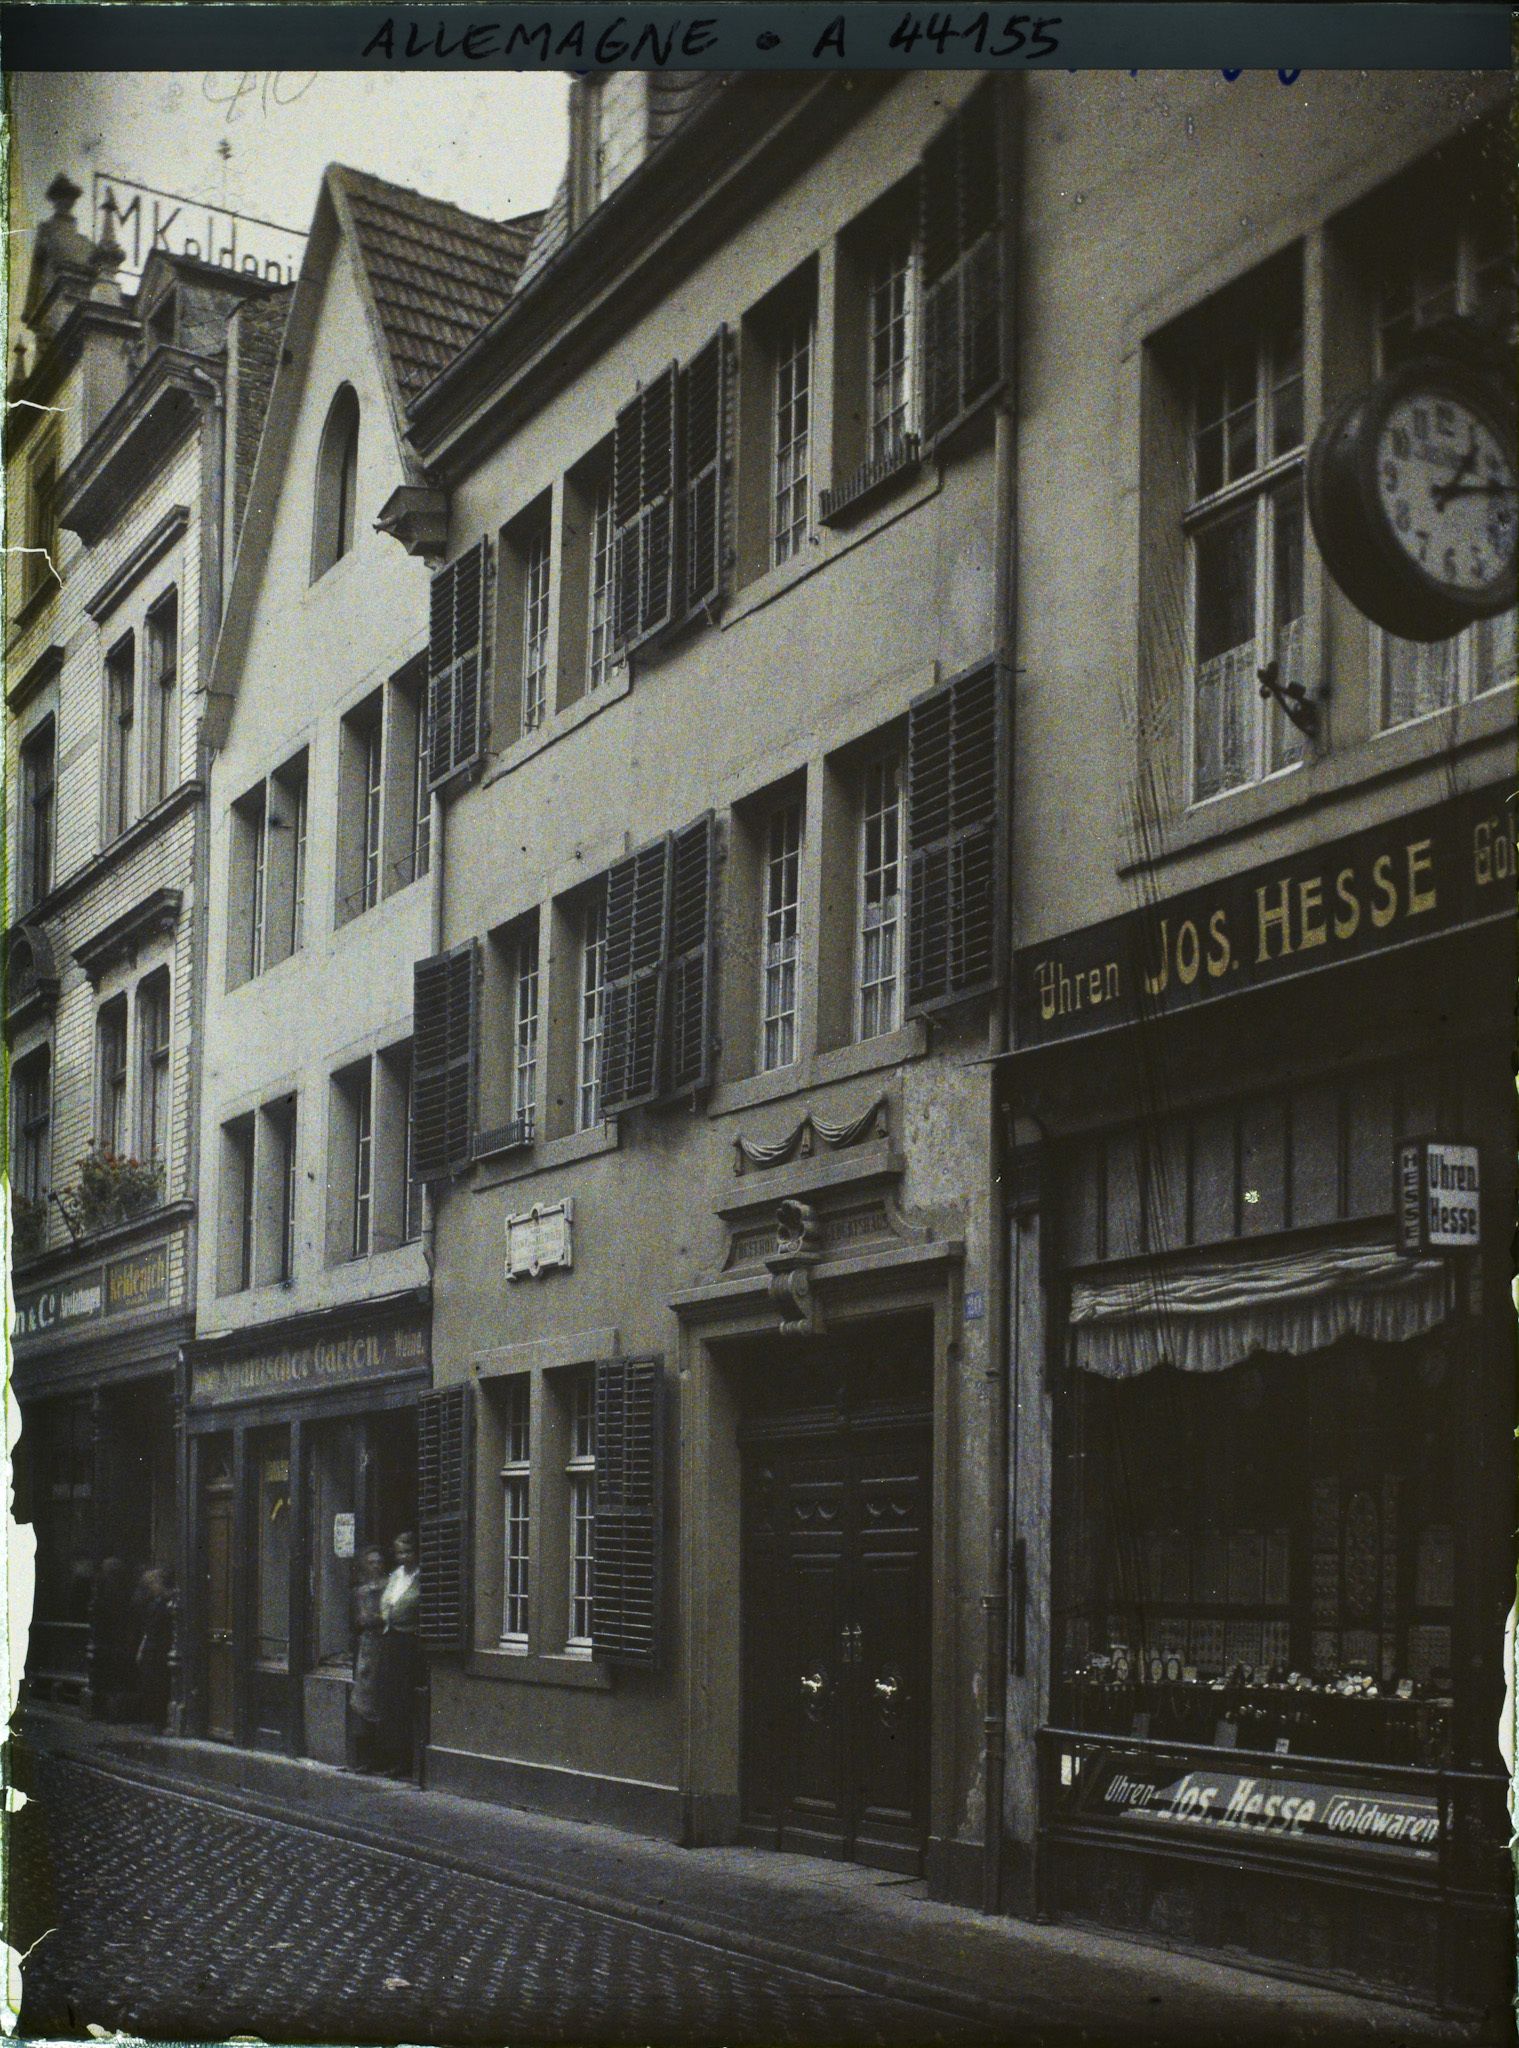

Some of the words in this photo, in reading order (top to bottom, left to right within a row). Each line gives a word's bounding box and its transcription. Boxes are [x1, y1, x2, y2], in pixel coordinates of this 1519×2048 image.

[361, 17, 719, 66] ALLEMAGNE
[812, 15, 847, 58] A
[888, 12, 1063, 60] 44155
[1034, 961, 1120, 1021] Uhren
[1145, 910, 1239, 995] JOS.
[1255, 839, 1437, 964] HESSE
[1216, 1778, 1316, 1835] Hesse
[1328, 1800, 1440, 1843] Goldwaren
